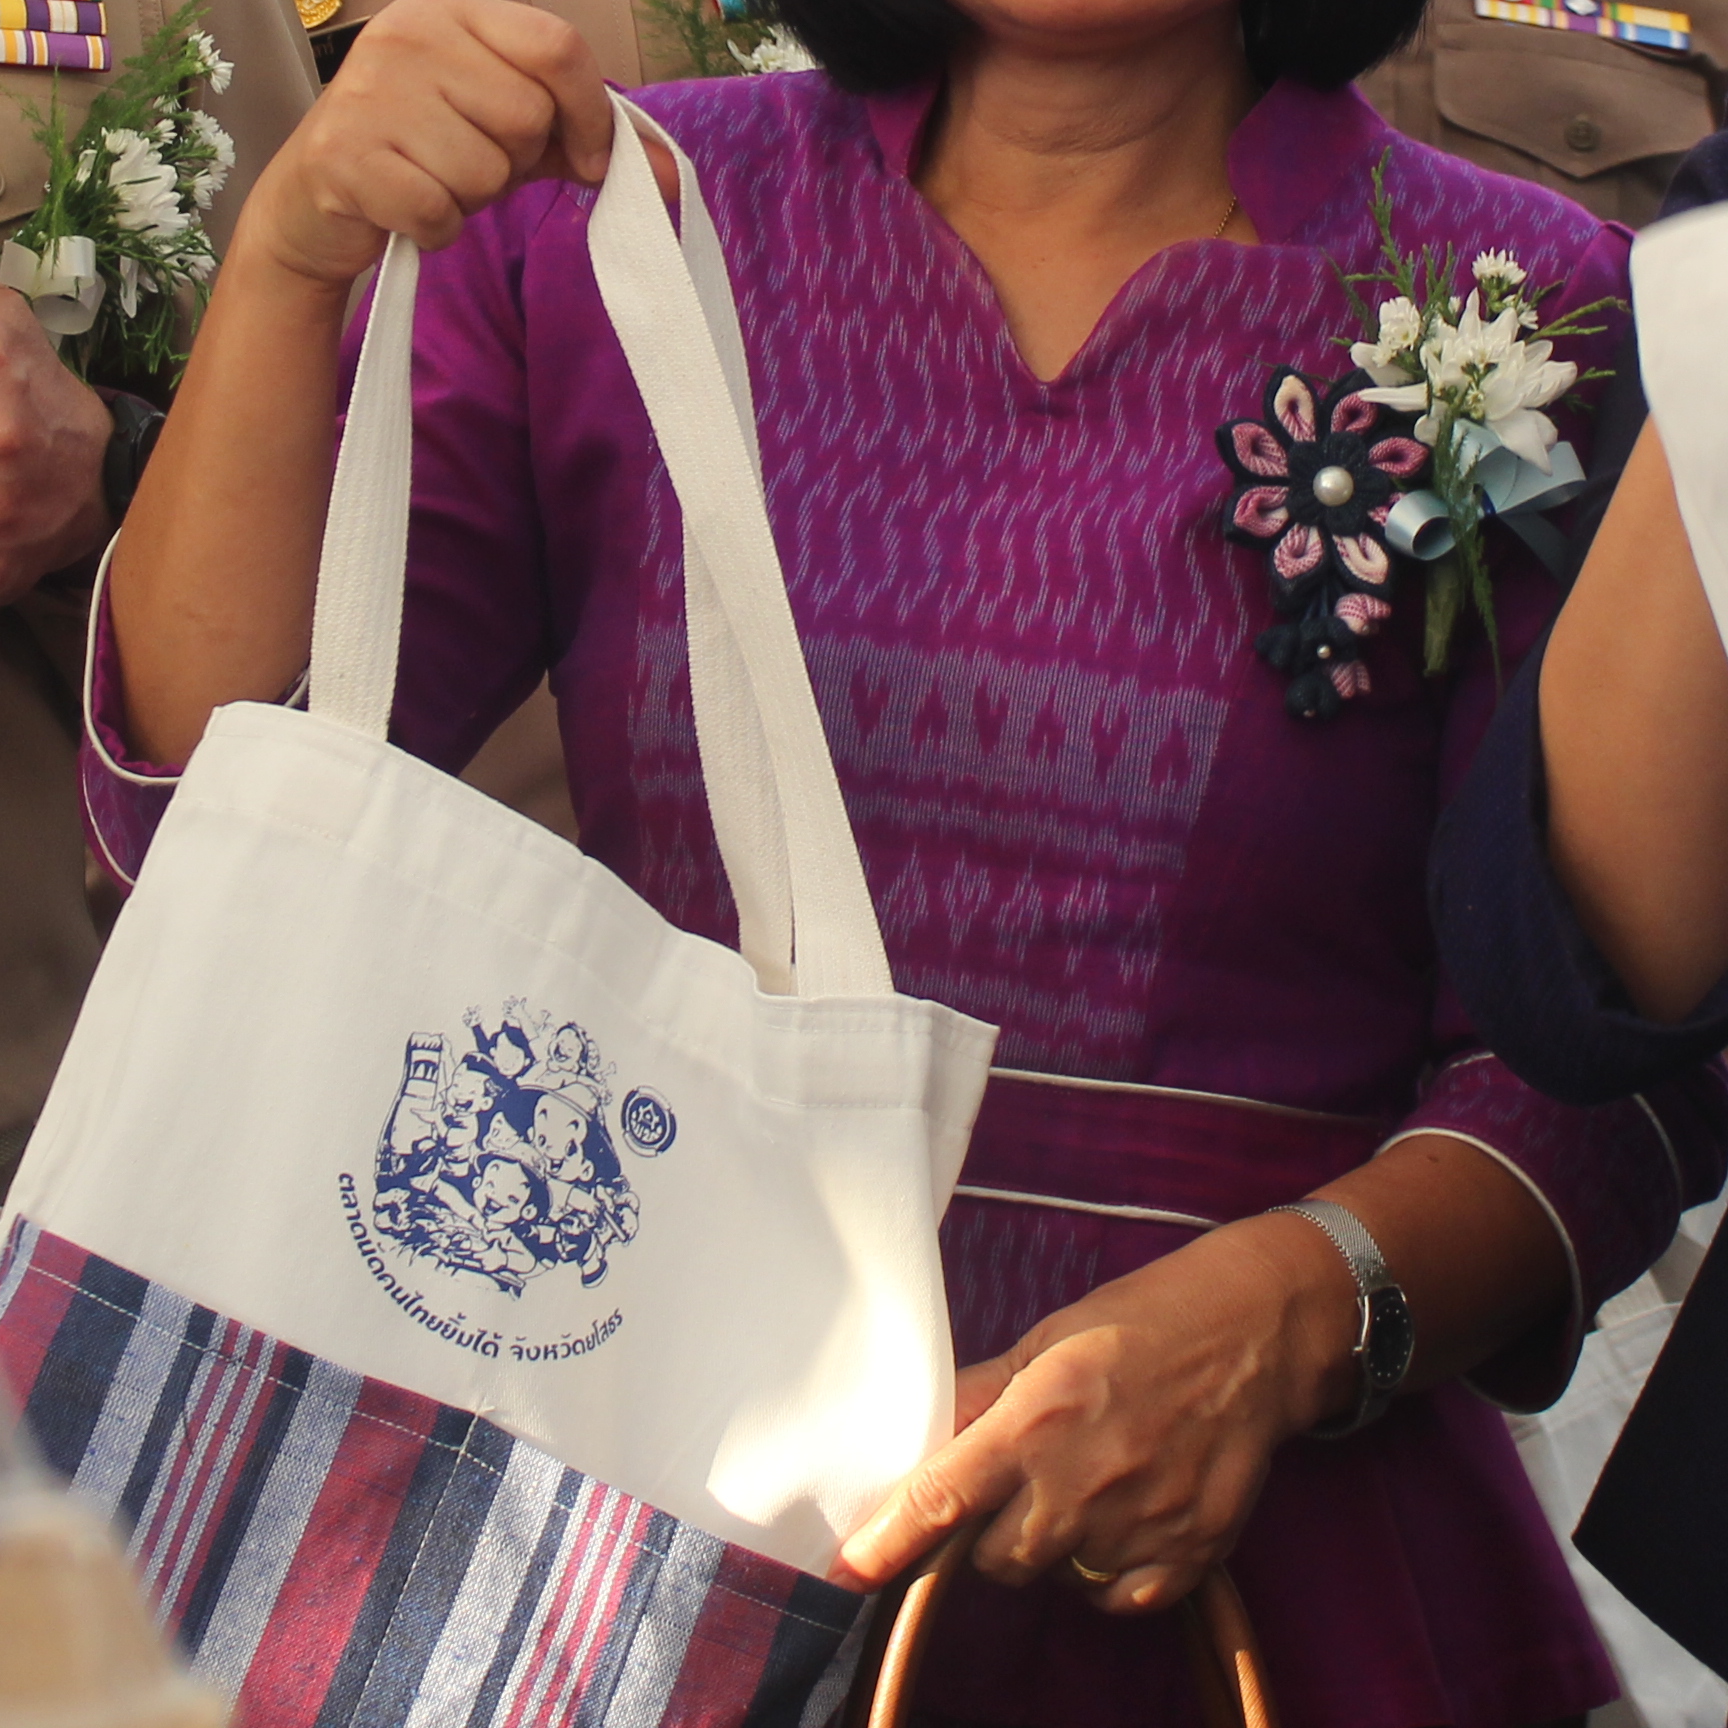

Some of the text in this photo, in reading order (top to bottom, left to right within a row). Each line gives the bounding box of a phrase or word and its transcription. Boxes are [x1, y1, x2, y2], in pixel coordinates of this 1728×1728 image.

[338, 1172, 623, 1361] ตลาดนัดคนไทยยิ้มได้ จังหวัดยโสธร
